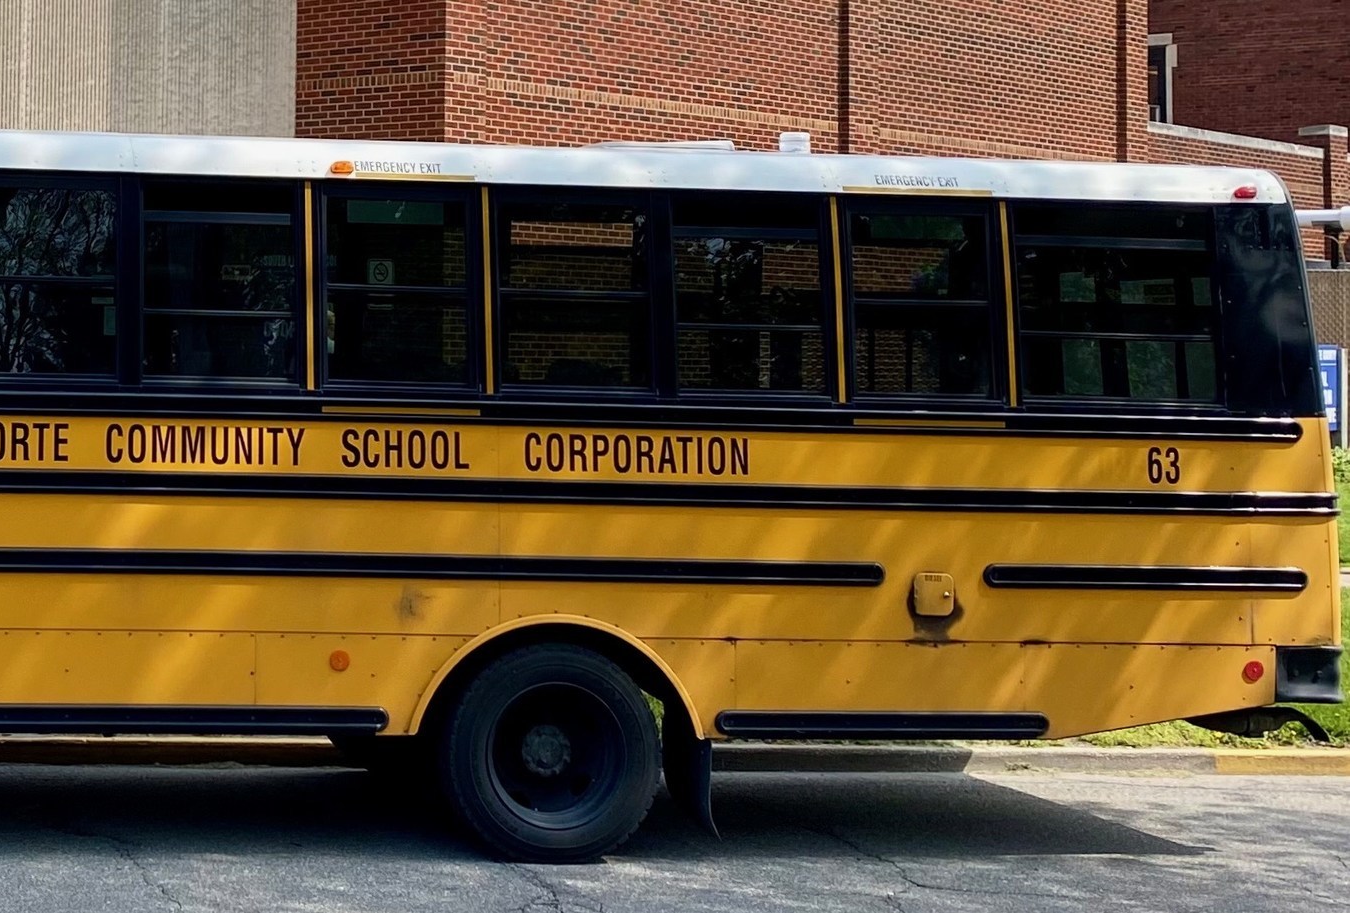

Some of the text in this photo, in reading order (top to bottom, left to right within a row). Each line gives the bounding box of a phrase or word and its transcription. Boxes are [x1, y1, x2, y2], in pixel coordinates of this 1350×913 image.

[354, 160, 442, 174] EMERGENCY EXIT
[874, 174, 959, 188] EMERGENCY EXIT
[105, 423, 306, 467] COMMUNITY
[341, 428, 470, 470] SCHOOL
[524, 432, 750, 476] CORPORATION
[1147, 446, 1180, 485] 63
